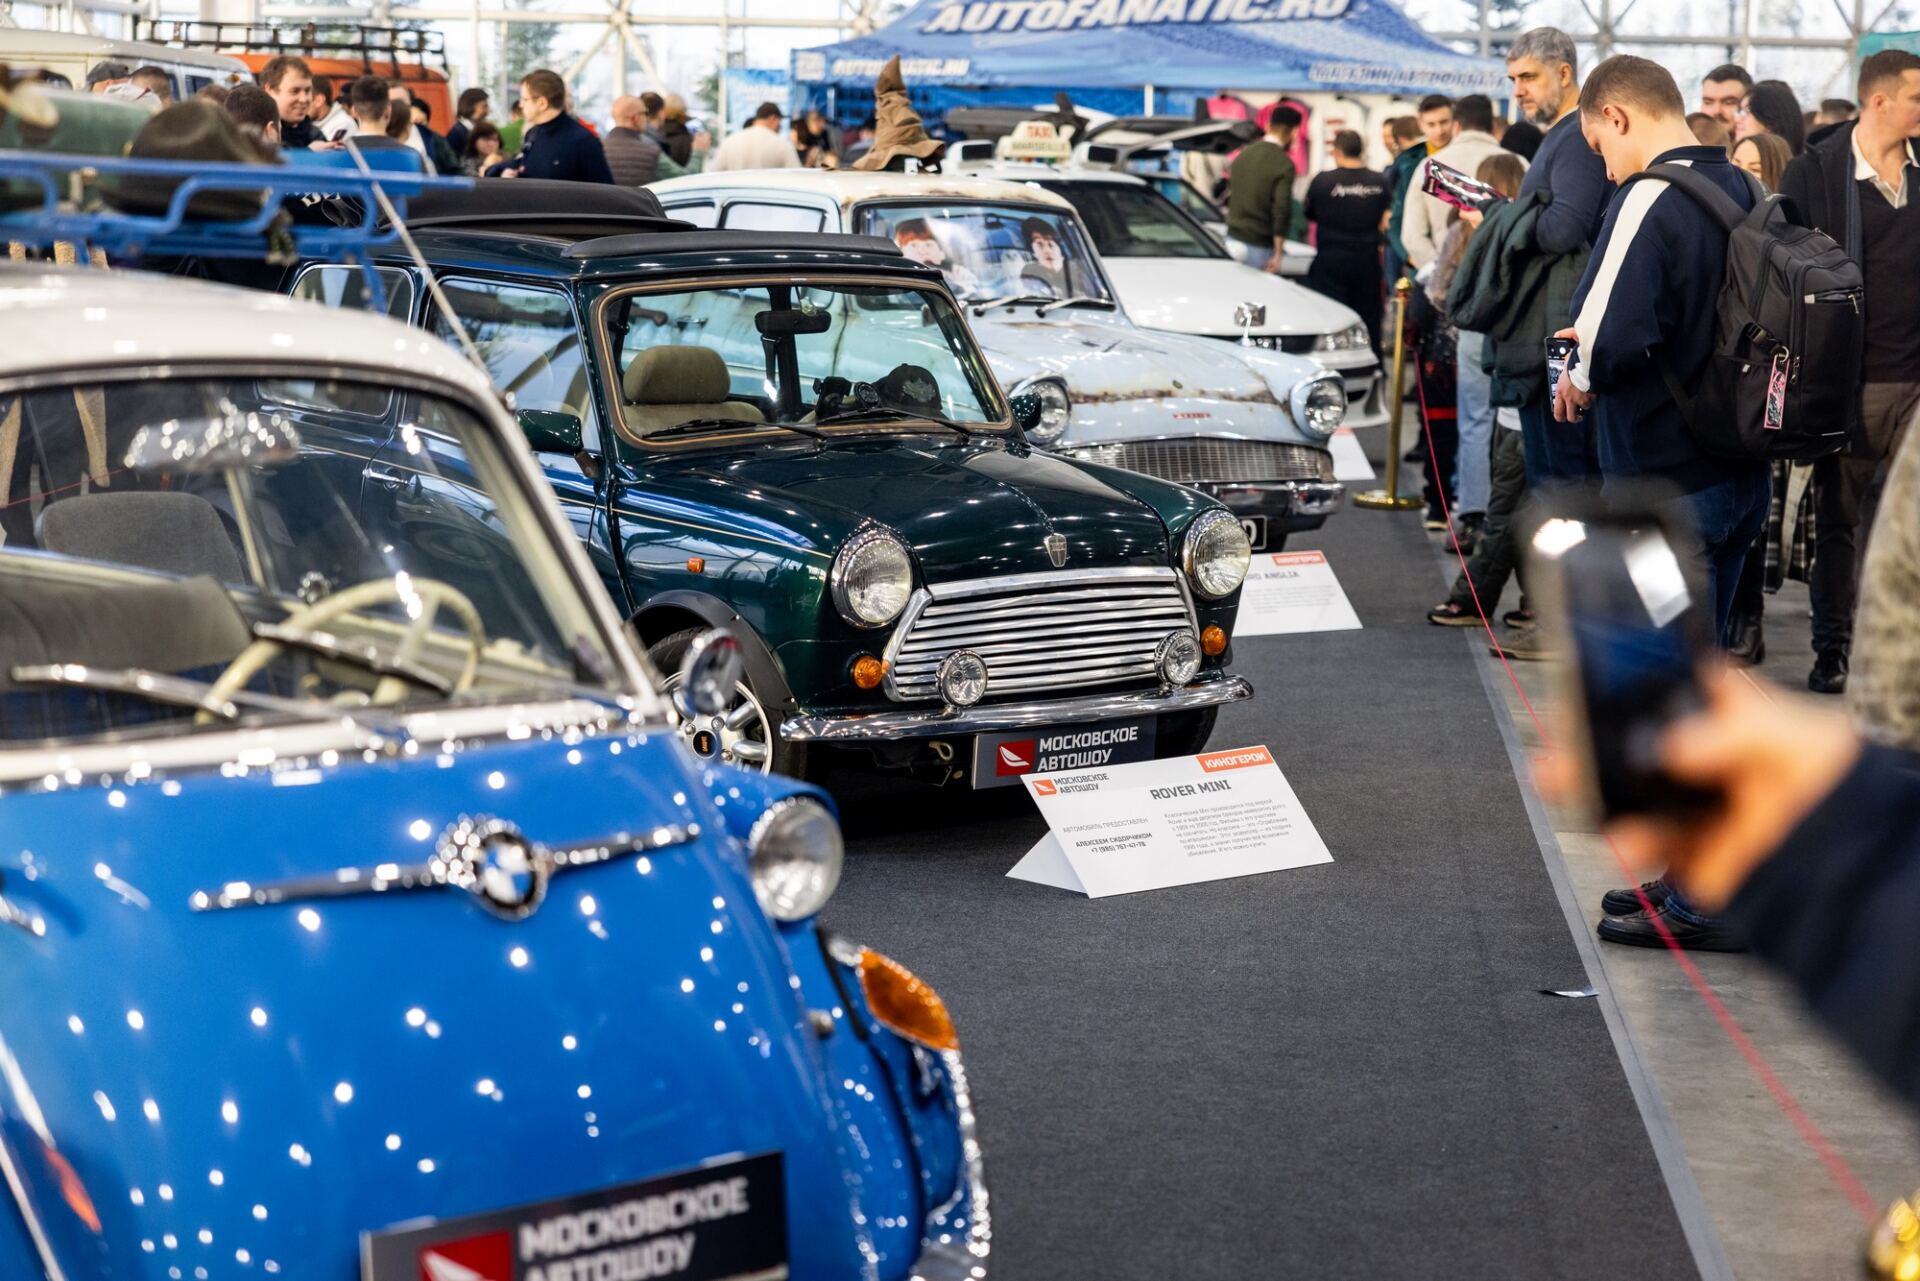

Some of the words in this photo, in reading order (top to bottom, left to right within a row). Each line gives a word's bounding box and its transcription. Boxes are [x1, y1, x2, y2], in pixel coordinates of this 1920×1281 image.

[919, 0, 1354, 34] AUTOFANATIC.RU
[1027, 125, 1052, 138] TAXI
[1039, 726, 1139, 753] МОСКОВСКОЕ
[1037, 748, 1112, 772] АВТОШОУ
[1204, 752, 1267, 769] КИНОГЕРОИ
[1053, 772, 1110, 786] МОСКОВСКОЕ
[1059, 783, 1099, 795] АВТОШОУ
[1150, 783, 1197, 800] ROVER
[1197, 779, 1232, 794] MINI
[1075, 837, 1108, 848] АЛЕКСЕЕМ
[518, 1176, 749, 1262] МОСКОВСКОЕ
